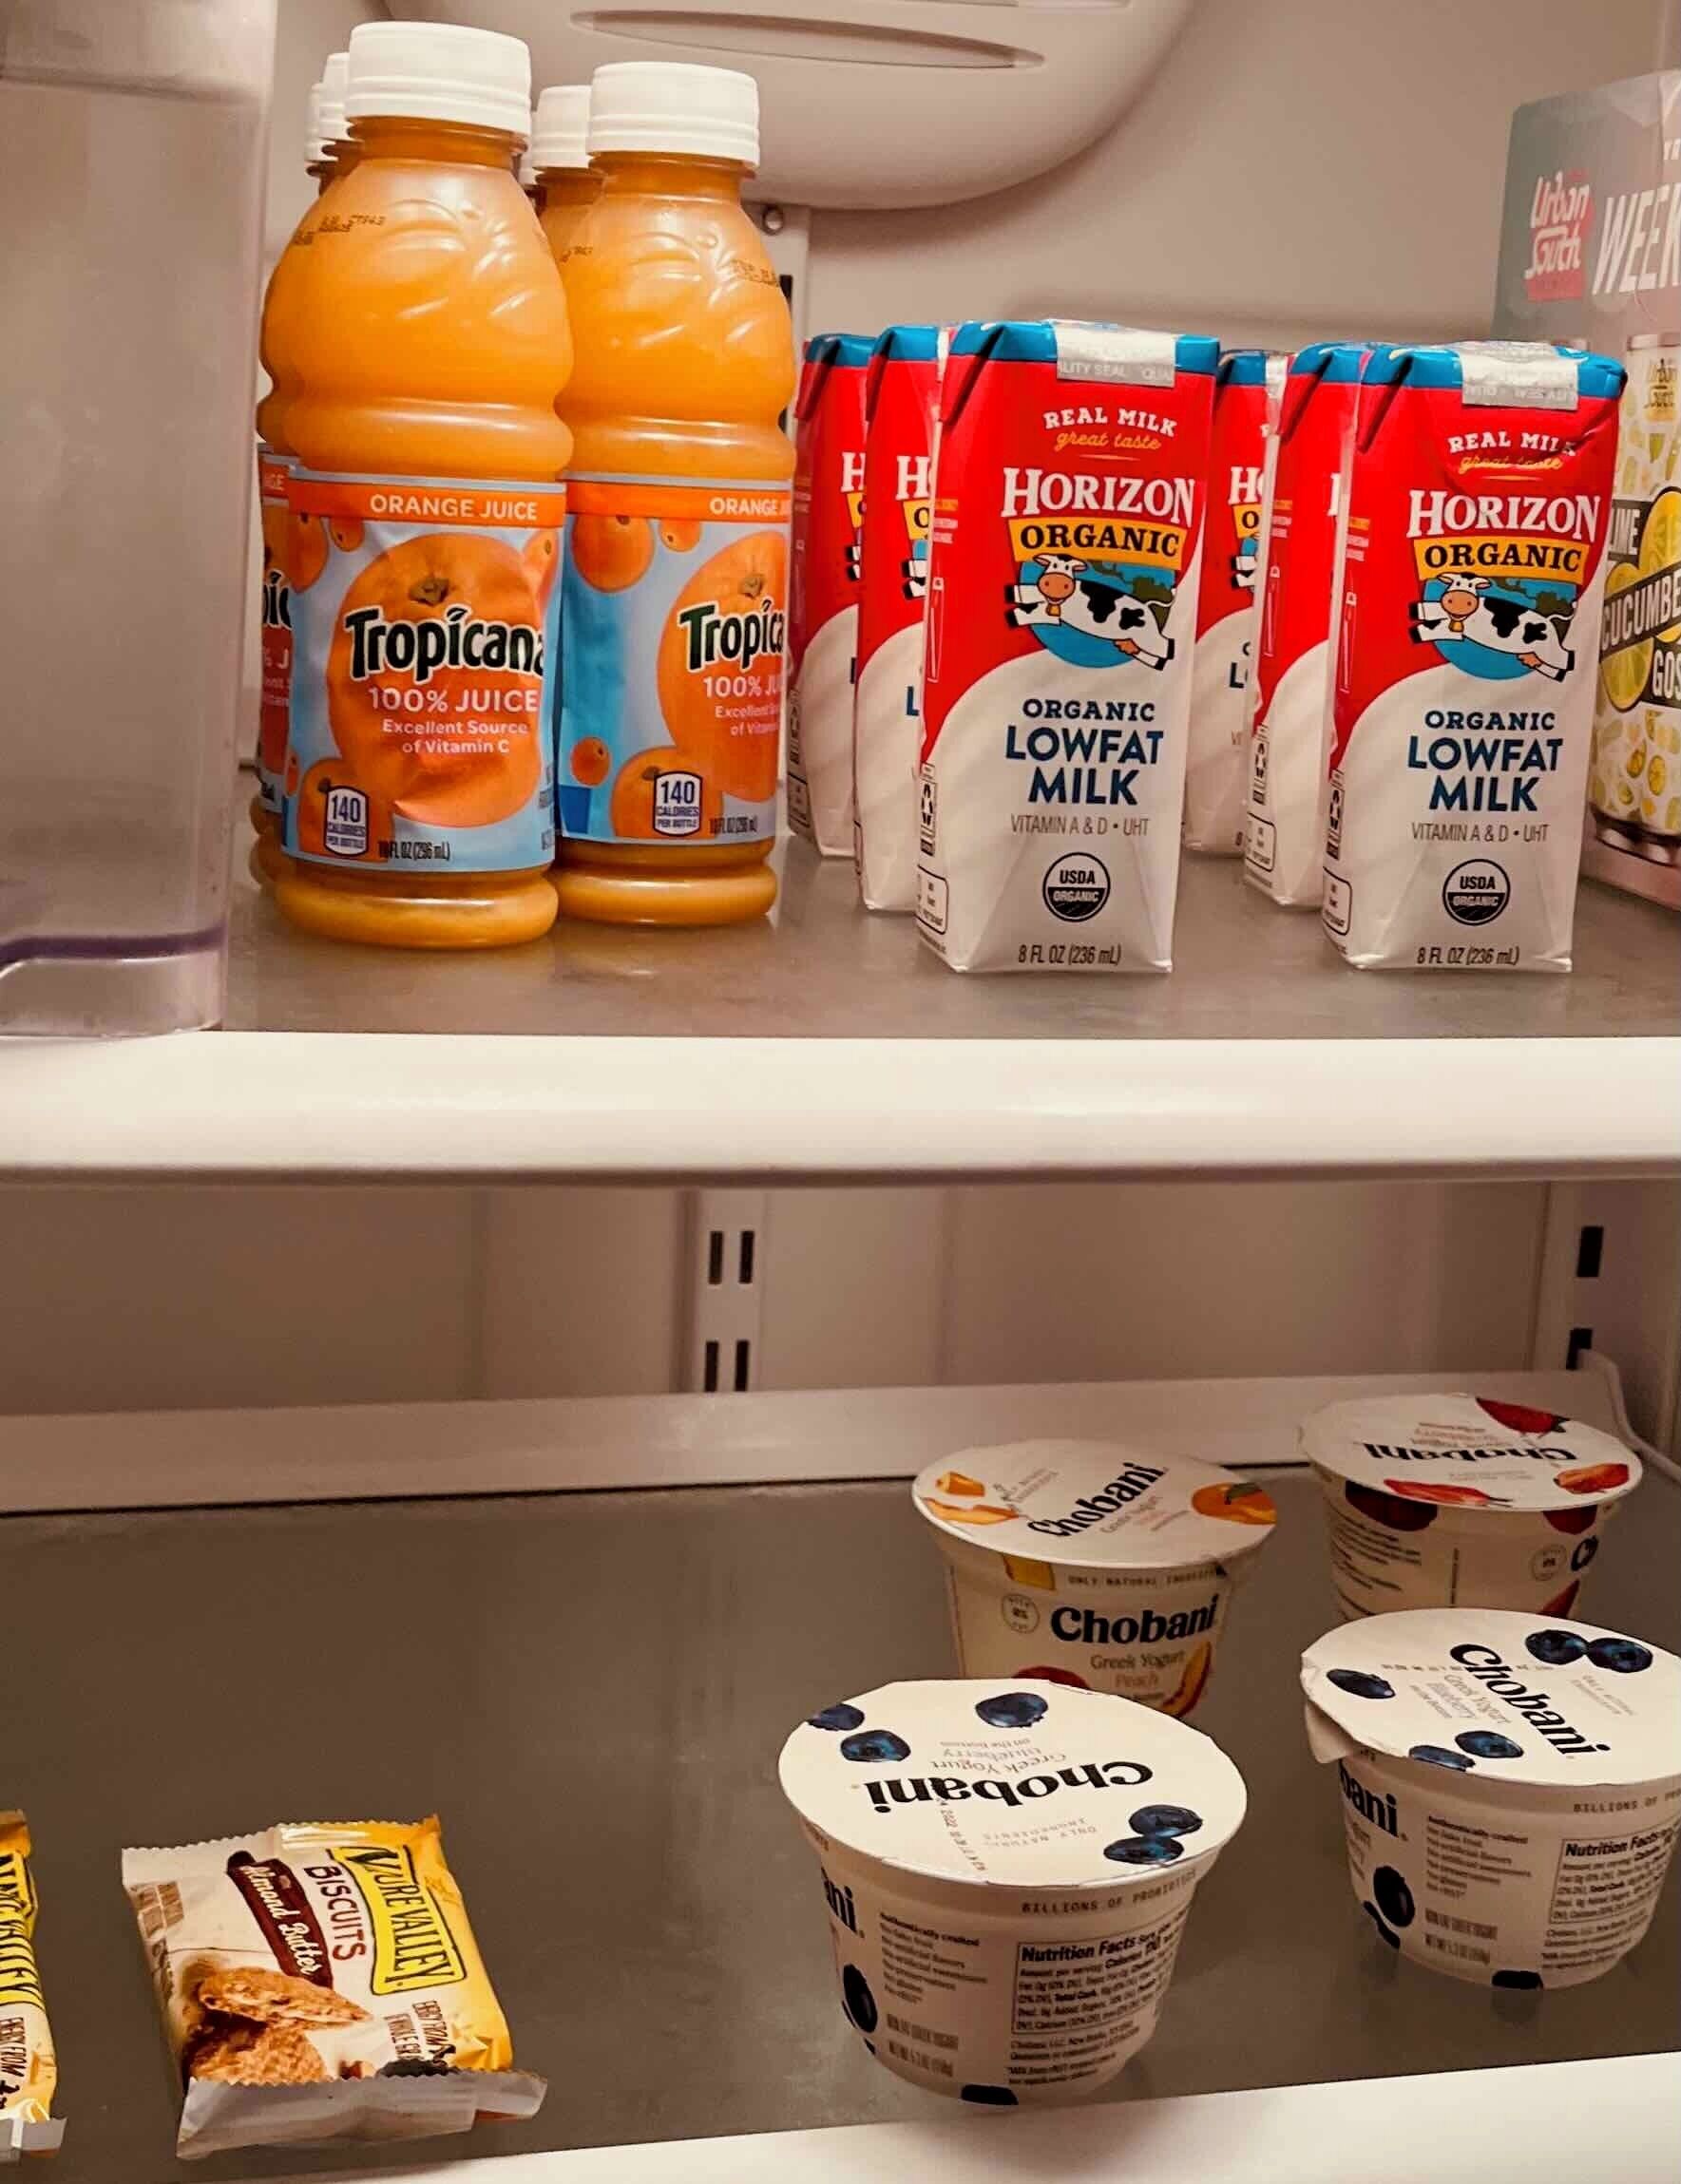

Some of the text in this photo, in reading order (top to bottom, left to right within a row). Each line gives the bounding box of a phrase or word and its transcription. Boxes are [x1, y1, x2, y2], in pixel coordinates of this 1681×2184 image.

[1530, 171, 1589, 228] Urban
[1043, 407, 1178, 438] REAL MILK
[1054, 431, 1162, 452] great taste
[1448, 430, 1512, 453] REAL
[370, 493, 538, 521] ORANGE JUICE
[709, 497, 777, 516] ORANGE
[1001, 466, 1195, 528] HORIZON
[1406, 488, 1601, 543] HORIZON
[1021, 524, 1180, 558] ORGANIC
[1424, 542, 1582, 572] ORGANIC
[703, 675, 761, 697] 100%
[369, 687, 540, 712] 100% JUICE
[1022, 698, 1156, 723] ORGANIC
[382, 718, 528, 735] Excellent Source
[1424, 710, 1556, 731] ORGANIC
[402, 739, 510, 754] of Vitamin C
[1005, 725, 1164, 765] LOWFAT
[1407, 734, 1564, 772] LOWFAT
[660, 780, 696, 805] 140
[1028, 766, 1140, 807] MILK
[1428, 774, 1540, 812] MILK
[332, 796, 361, 823] 140
[656, 806, 699, 817] CALORIES
[1011, 814, 1150, 836] VITAMIN A & D UHT
[1412, 823, 1549, 843] VITAMIN A & D UHT
[1060, 869, 1096, 884] USDA
[1460, 876, 1496, 890] USDA
[1053, 889, 1099, 903] ORGANIC
[1018, 944, 1121, 966] 8 FL OZ (236 mL)
[1416, 946, 1519, 966] 8 FL OZ (236 mL)
[1027, 1461, 1166, 1538] Chobani
[1050, 1592, 1220, 1644] Chobani
[1090, 1650, 1185, 1670] Greek Yogurt
[1449, 1643, 1612, 1757] Chobani
[929, 1752, 1067, 1775] Greek Yogurt
[863, 1759, 1155, 1814] Chobani
[1565, 1841, 1628, 1857] Nutrition
[239, 1863, 323, 1976] Almond Butter
[303, 1865, 368, 1962] BISCUITS
[1021, 1900, 1098, 1915] BILLIONS
[1021, 1936, 1137, 1963] Nutrition Facts
